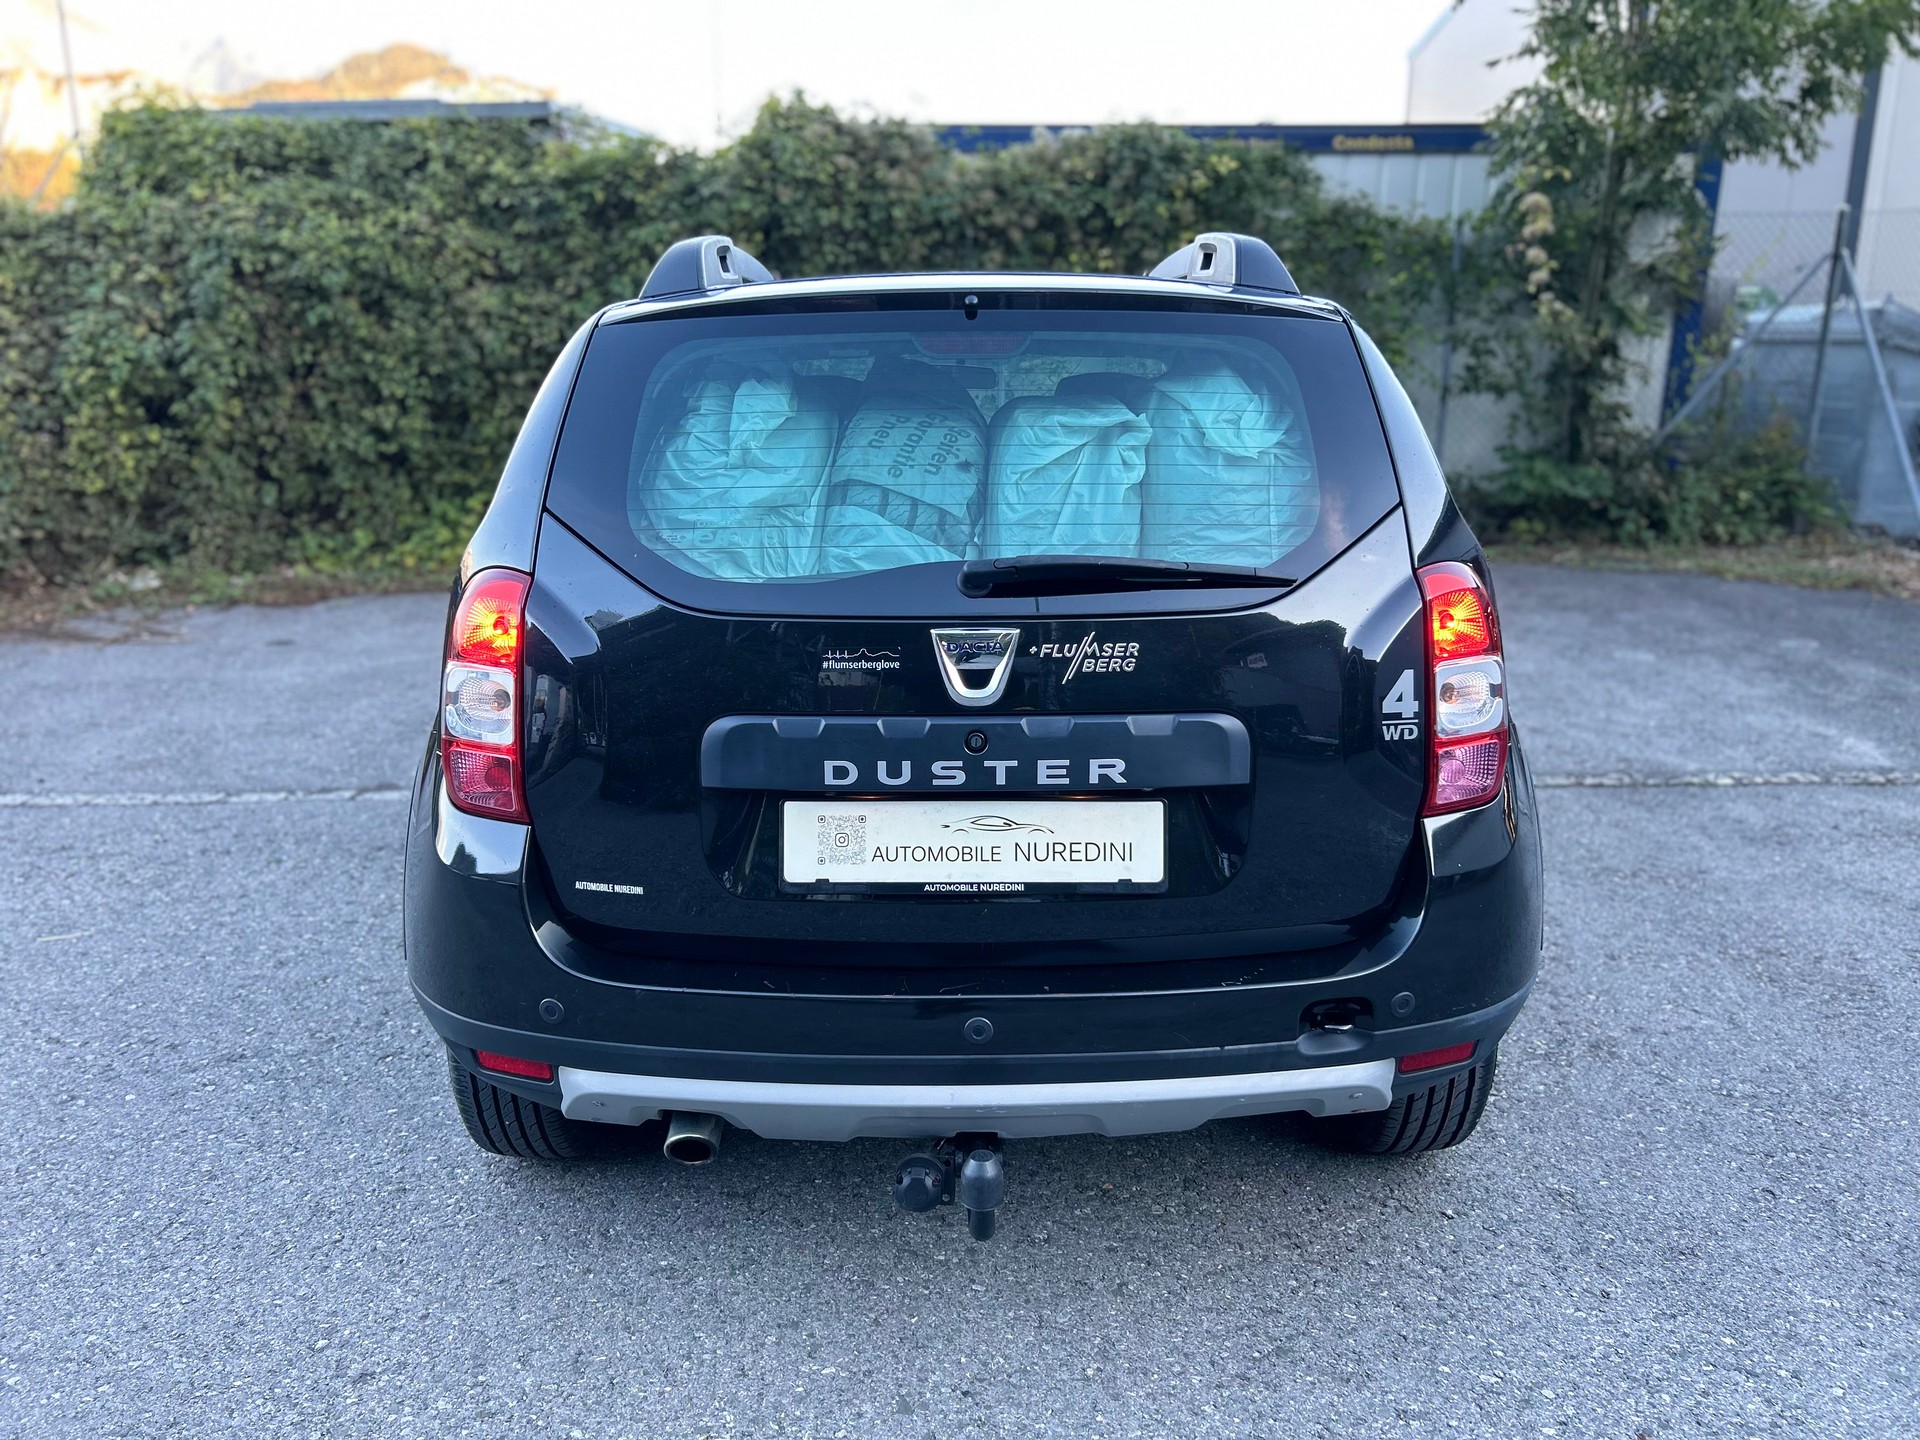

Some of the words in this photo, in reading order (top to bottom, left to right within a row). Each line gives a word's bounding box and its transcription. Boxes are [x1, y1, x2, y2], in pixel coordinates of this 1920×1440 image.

[946, 641, 1004, 653] DACIA
[822, 659, 900, 671] #flumserberglove
[1082, 658, 1137, 673] BERG
[823, 758, 1128, 786] DUSTER
[871, 845, 1002, 863] AUTOMOBILE
[1013, 841, 1134, 863] NUREDINI
[574, 880, 614, 893] AUTOMOBILE
[614, 884, 644, 895] NUREDINI
[923, 883, 979, 892] AUTOMOBILE
[979, 883, 1025, 892] NUREDINI
